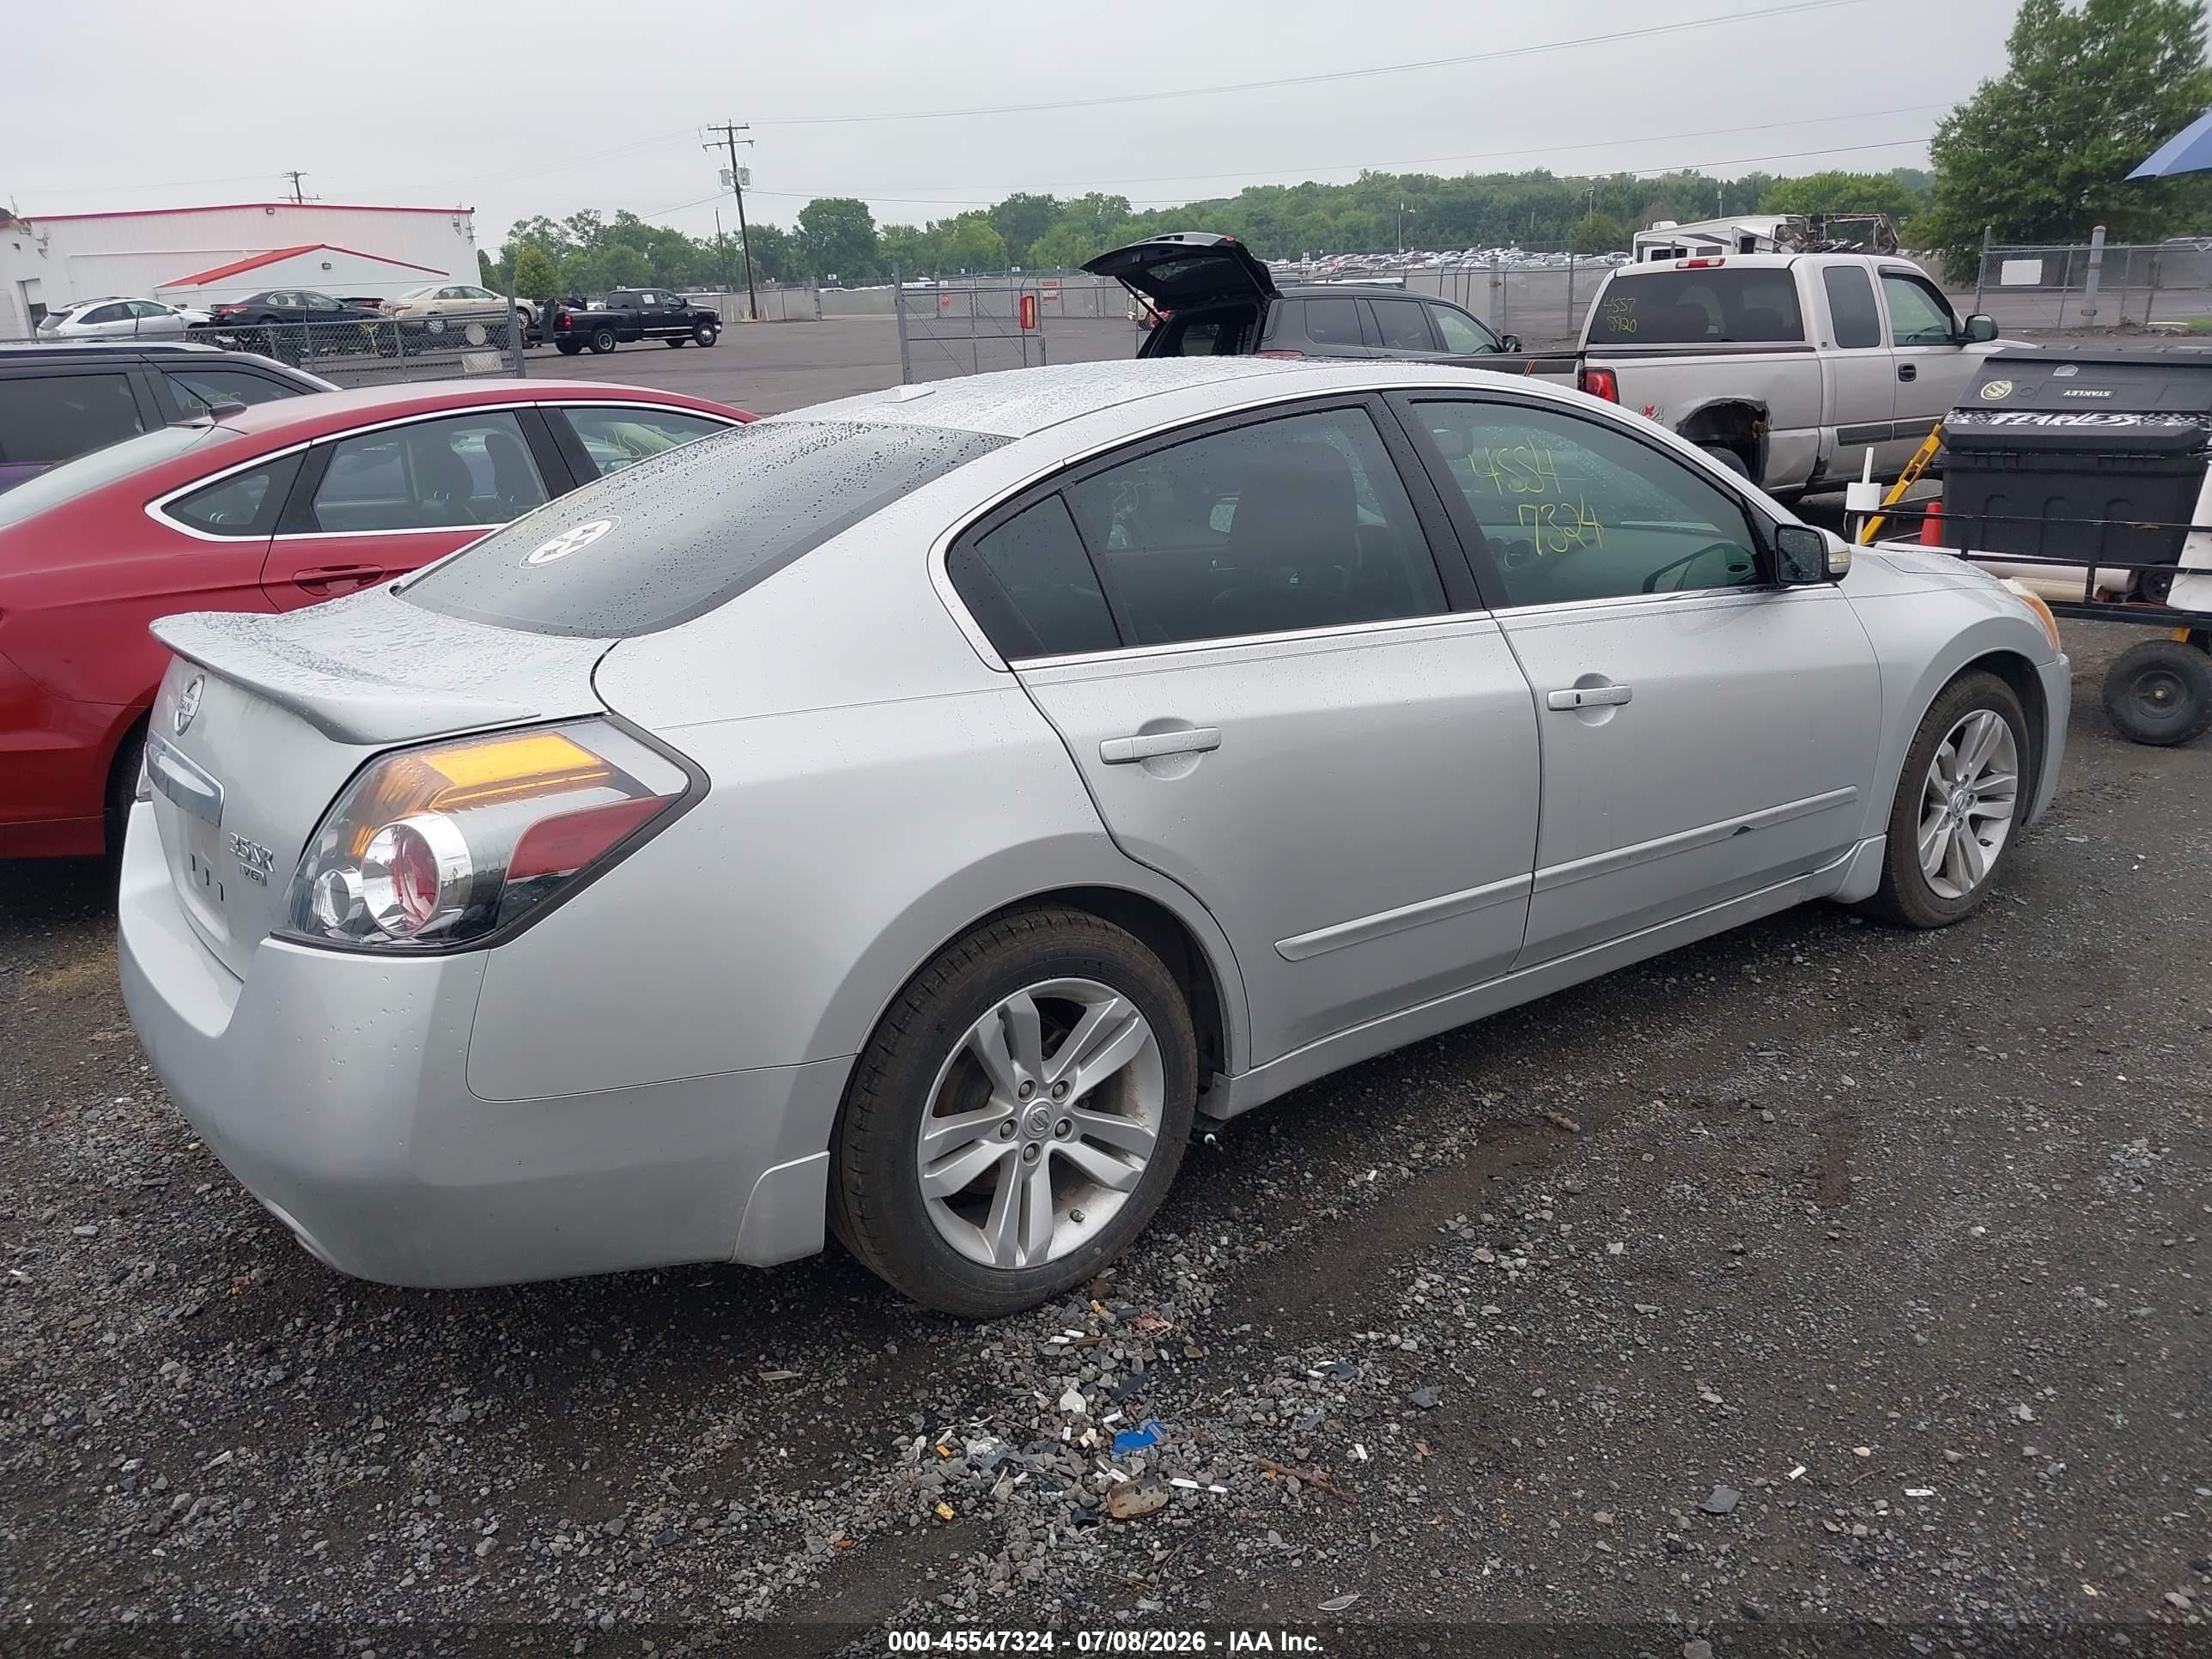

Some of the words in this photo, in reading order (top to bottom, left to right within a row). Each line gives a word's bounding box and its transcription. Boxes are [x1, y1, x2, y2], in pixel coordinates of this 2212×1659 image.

[1602, 296, 1636, 313] 4557
[1990, 411, 2143, 427] FEARLESS
[1468, 436, 1561, 495] 4554
[1517, 493, 1604, 556] 7324
